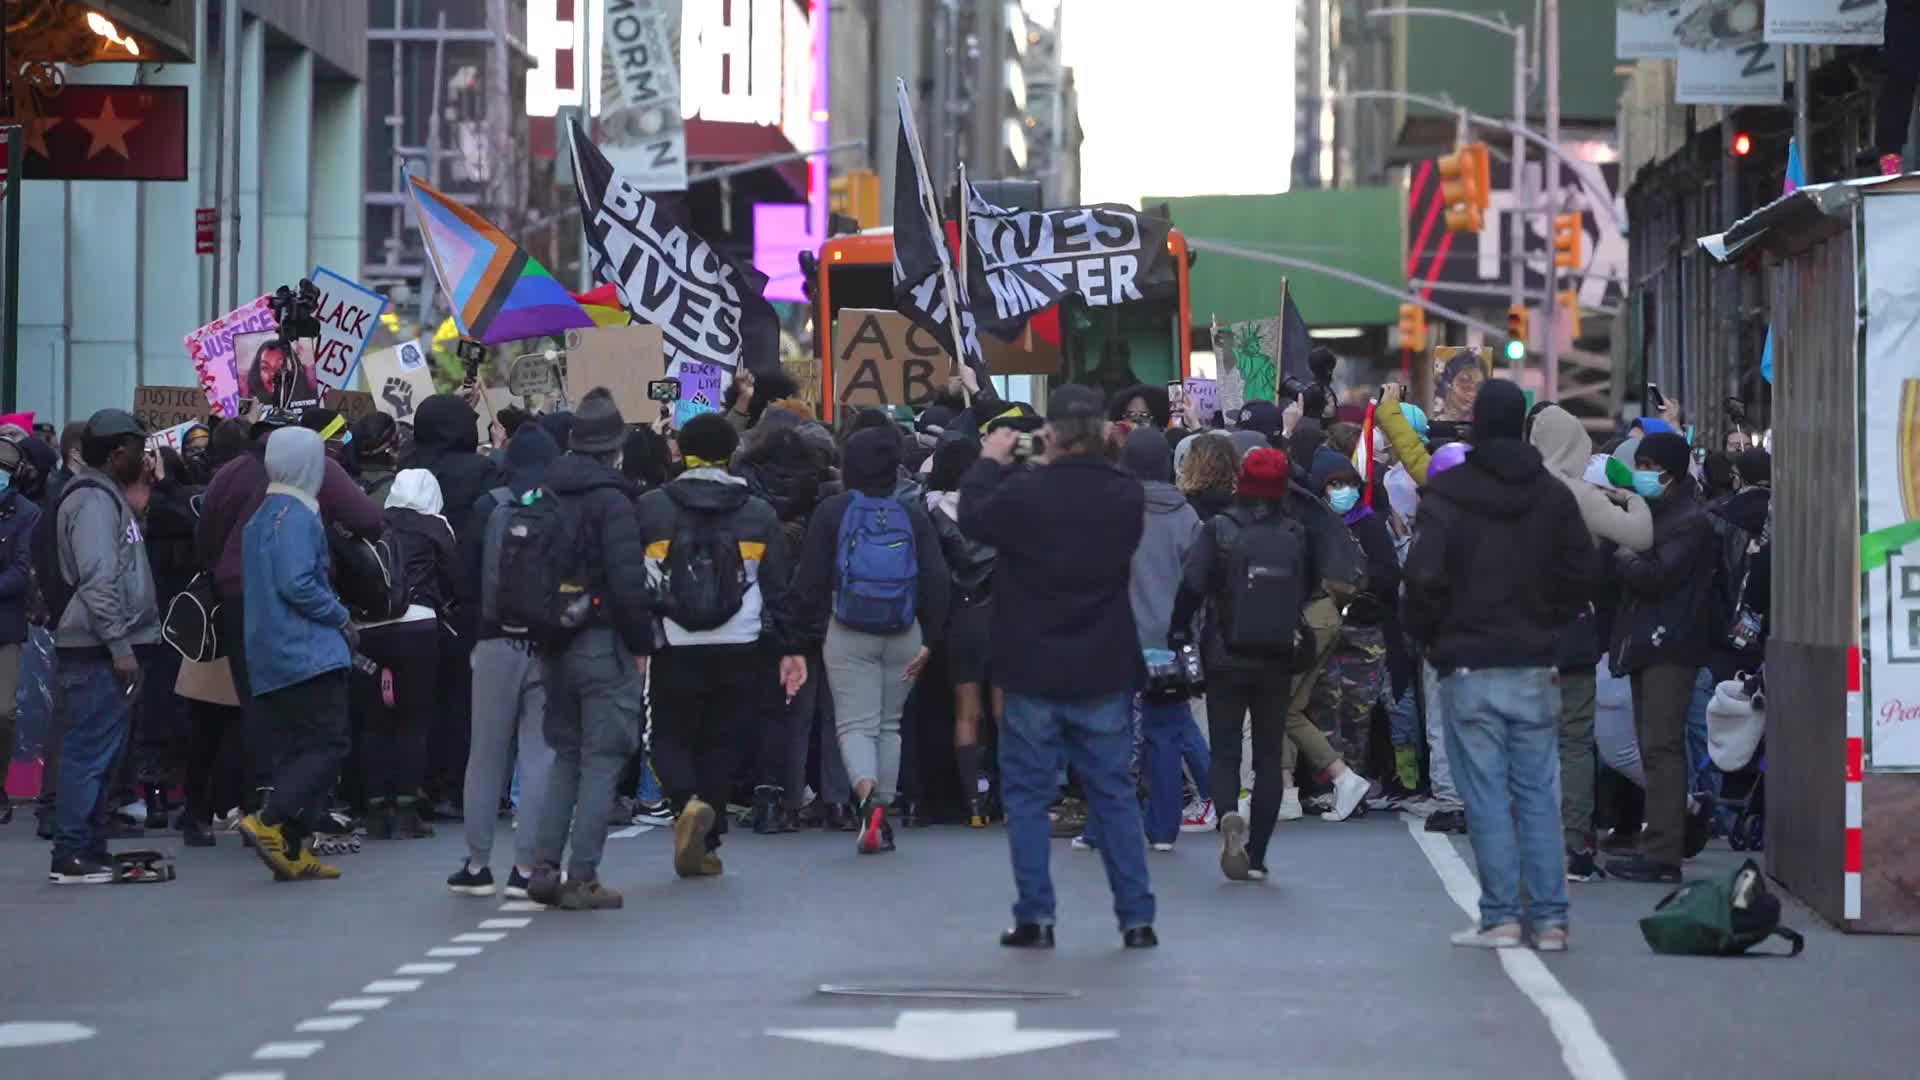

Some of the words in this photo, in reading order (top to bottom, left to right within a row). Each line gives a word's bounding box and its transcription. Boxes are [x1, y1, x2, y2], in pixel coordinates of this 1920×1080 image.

[602, 182, 741, 305] BLACK
[594, 216, 738, 355] LIVES
[203, 309, 273, 361] JUSTICE
[313, 292, 371, 340] LACK
[314, 334, 353, 377] VES
[680, 362, 717, 375] BLACK
